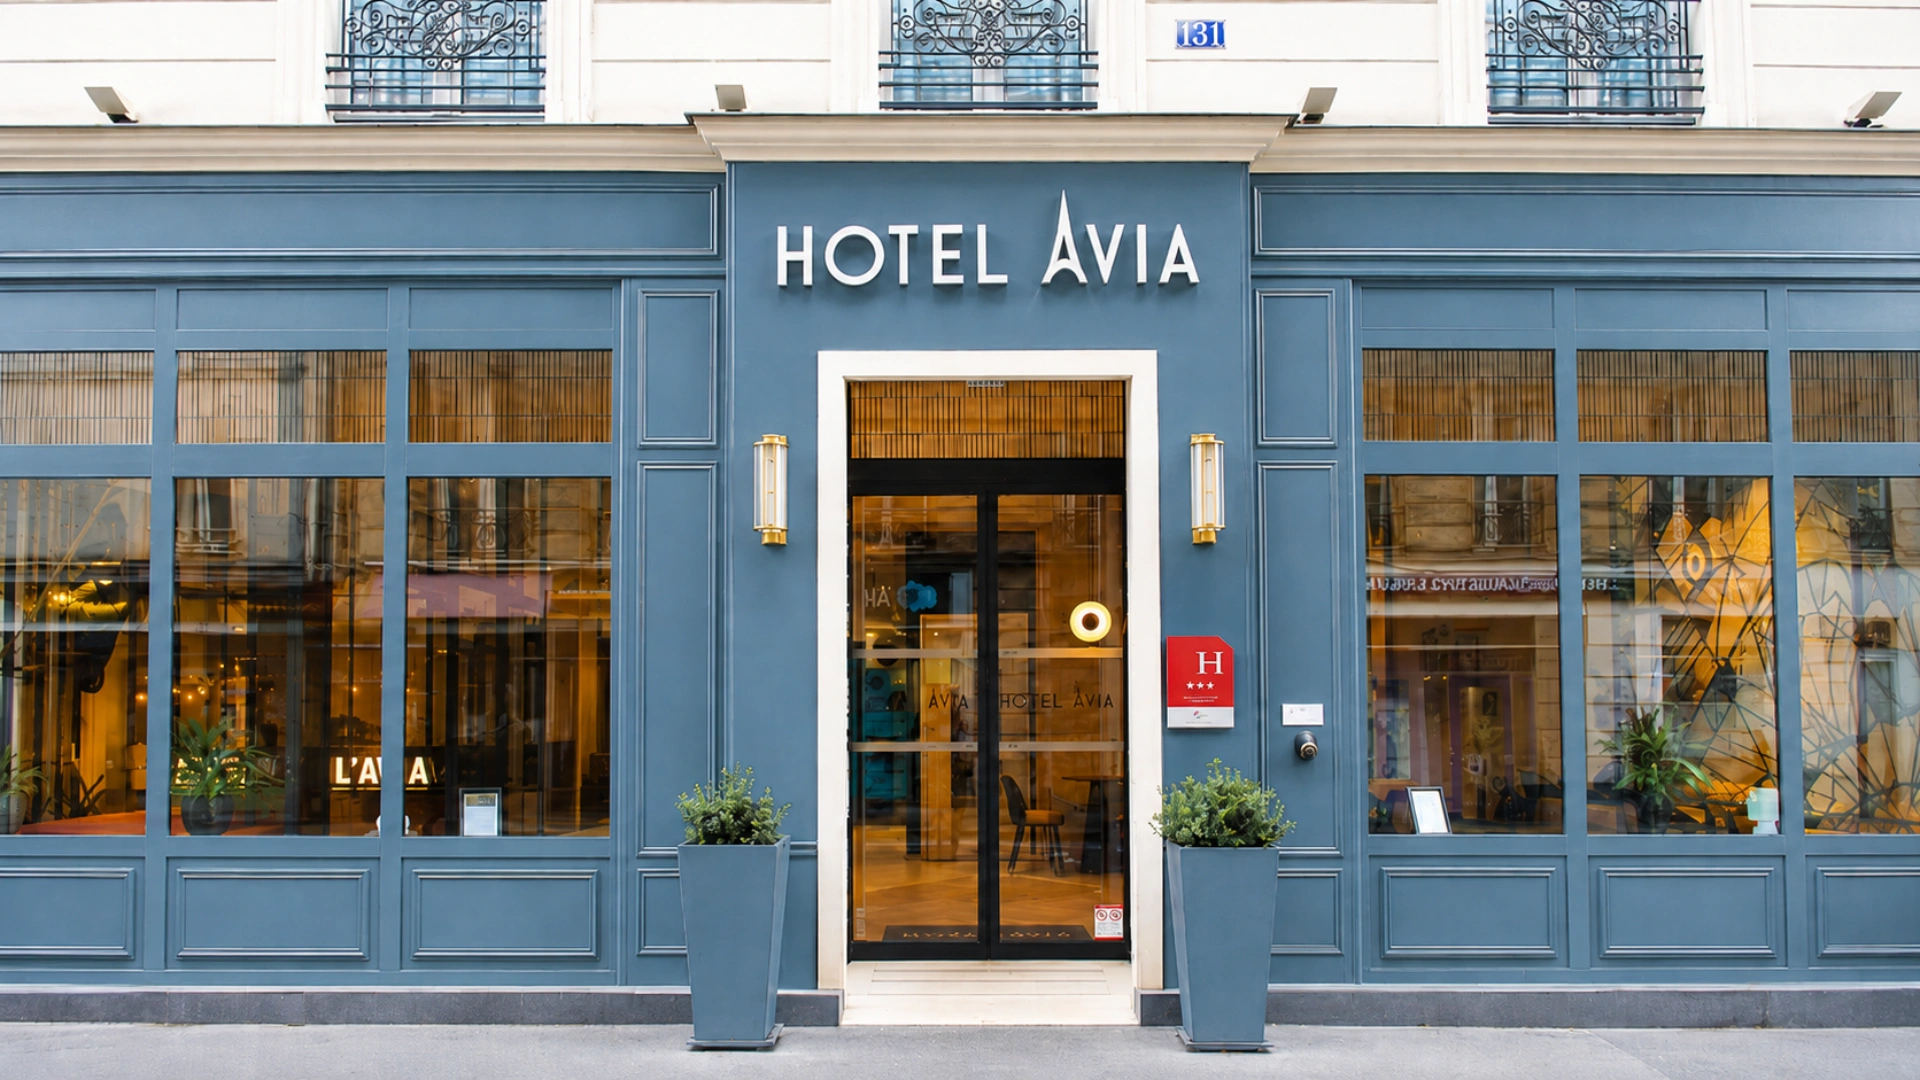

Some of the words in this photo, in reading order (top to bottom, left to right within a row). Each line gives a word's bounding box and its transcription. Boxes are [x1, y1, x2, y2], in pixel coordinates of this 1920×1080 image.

[1181, 21, 1220, 47] 131
[776, 224, 1009, 287] HOTEL
[1195, 651, 1224, 675] H
[1000, 693, 1063, 709] HOTEL
